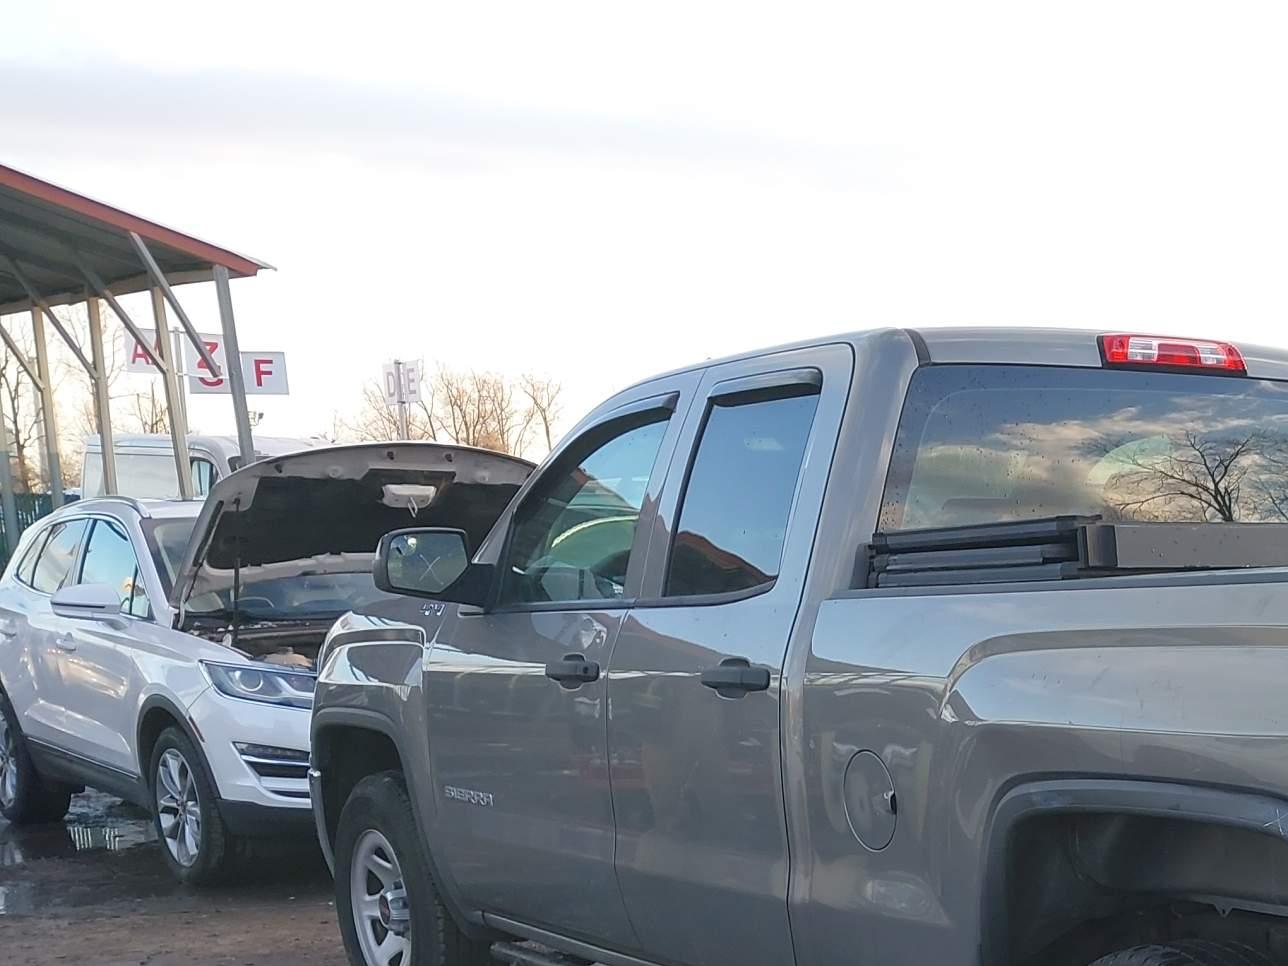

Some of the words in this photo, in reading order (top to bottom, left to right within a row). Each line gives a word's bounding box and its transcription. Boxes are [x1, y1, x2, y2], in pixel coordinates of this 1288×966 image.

[254, 359, 273, 387] F
[406, 367, 417, 395] E
[444, 785, 494, 807] SIERRA
